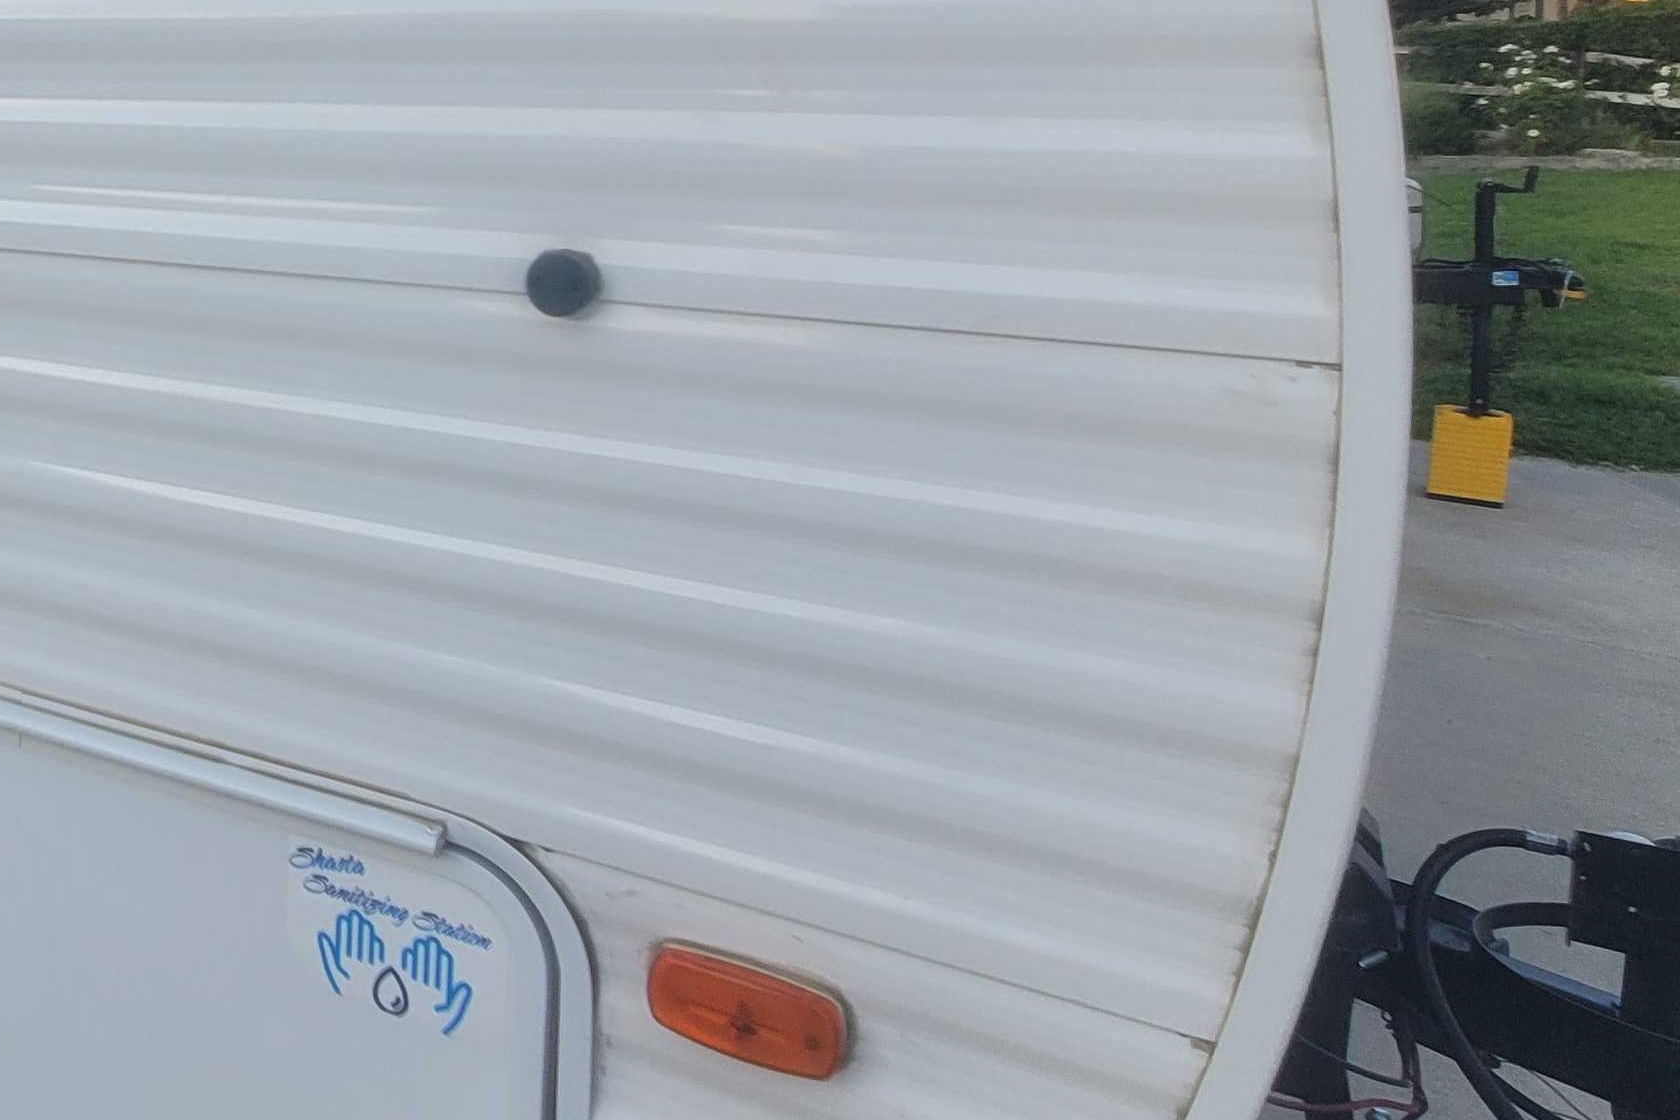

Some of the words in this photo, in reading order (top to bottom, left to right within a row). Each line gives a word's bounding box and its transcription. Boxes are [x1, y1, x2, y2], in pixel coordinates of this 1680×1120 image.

[289, 847, 365, 875] Shasta
[303, 874, 409, 927] Sanitizing
[412, 911, 493, 951] Station
